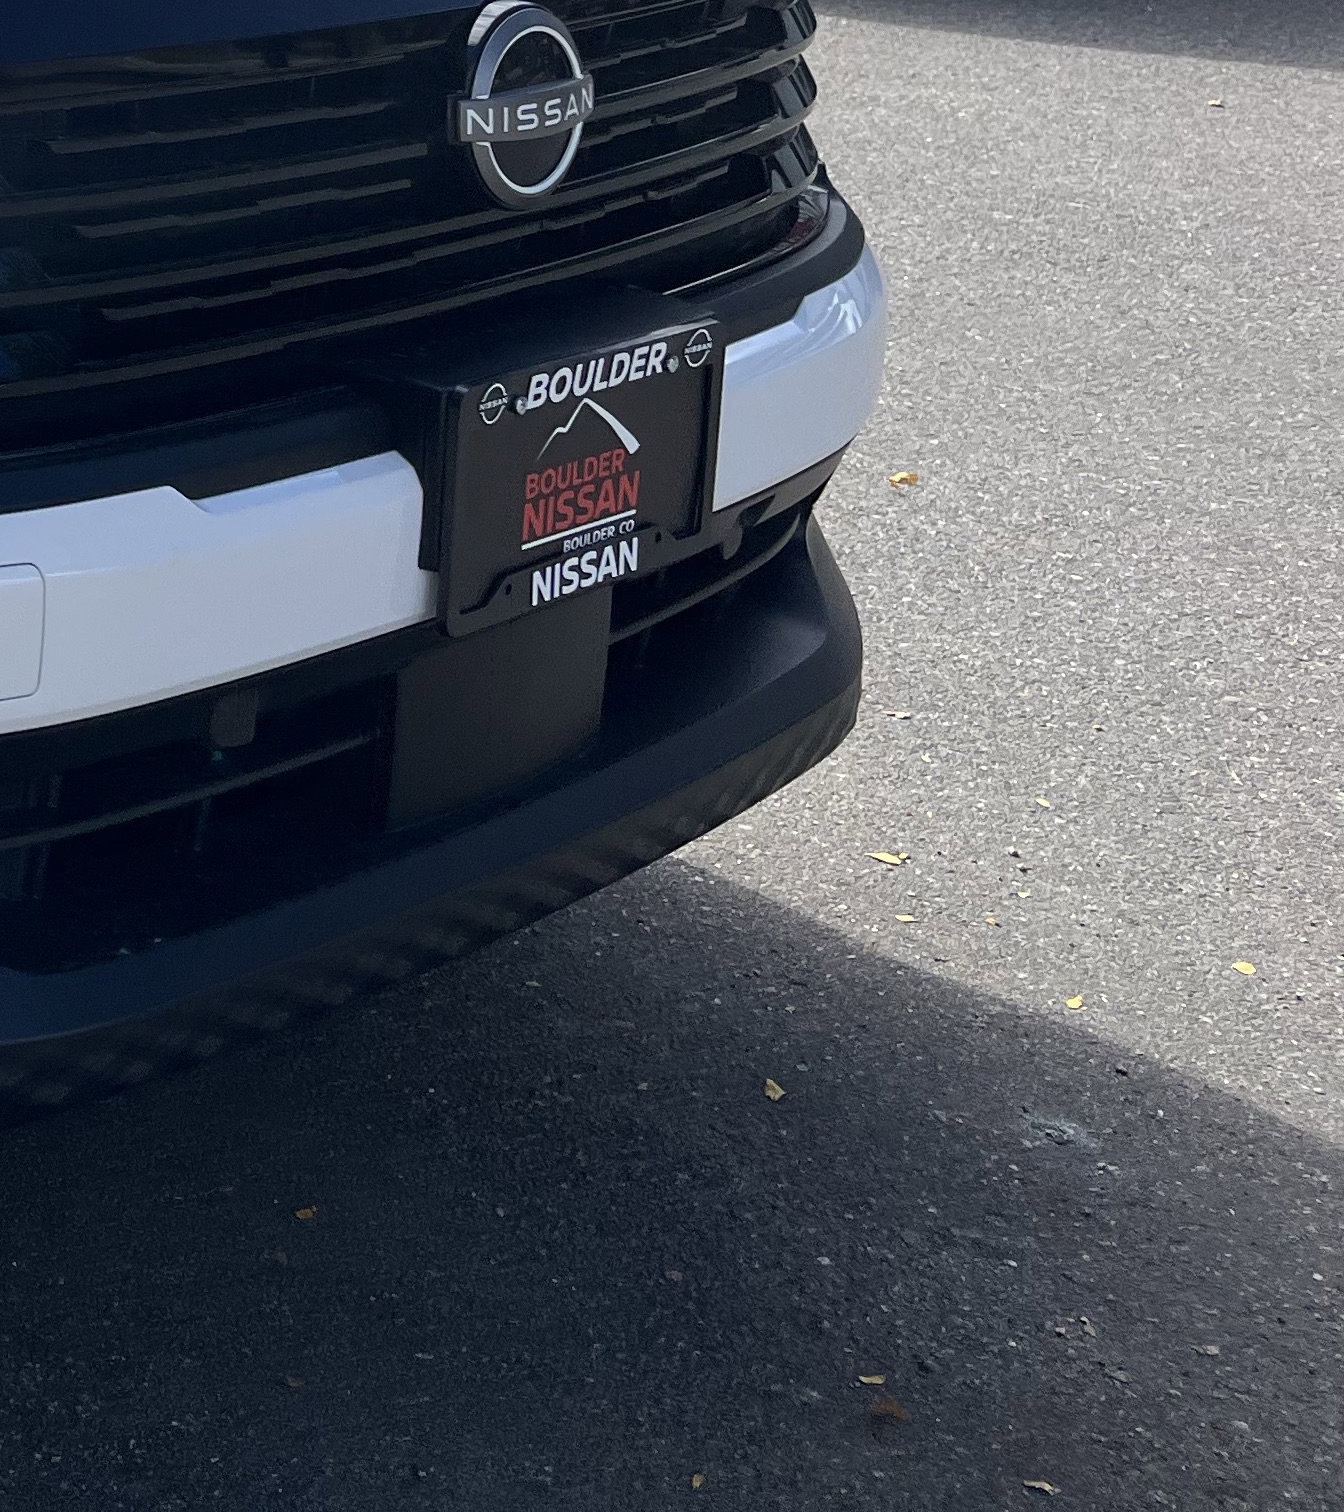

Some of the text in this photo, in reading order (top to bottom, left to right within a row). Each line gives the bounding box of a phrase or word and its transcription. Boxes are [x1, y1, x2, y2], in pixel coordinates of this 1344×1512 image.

[466, 85, 594, 135] NISSAN
[526, 342, 667, 410] BOULDER
[526, 448, 625, 499] BOULDER
[522, 470, 640, 541] NISSAN
[563, 519, 635, 553] BOULDER CO
[531, 537, 639, 607] NISSAN
